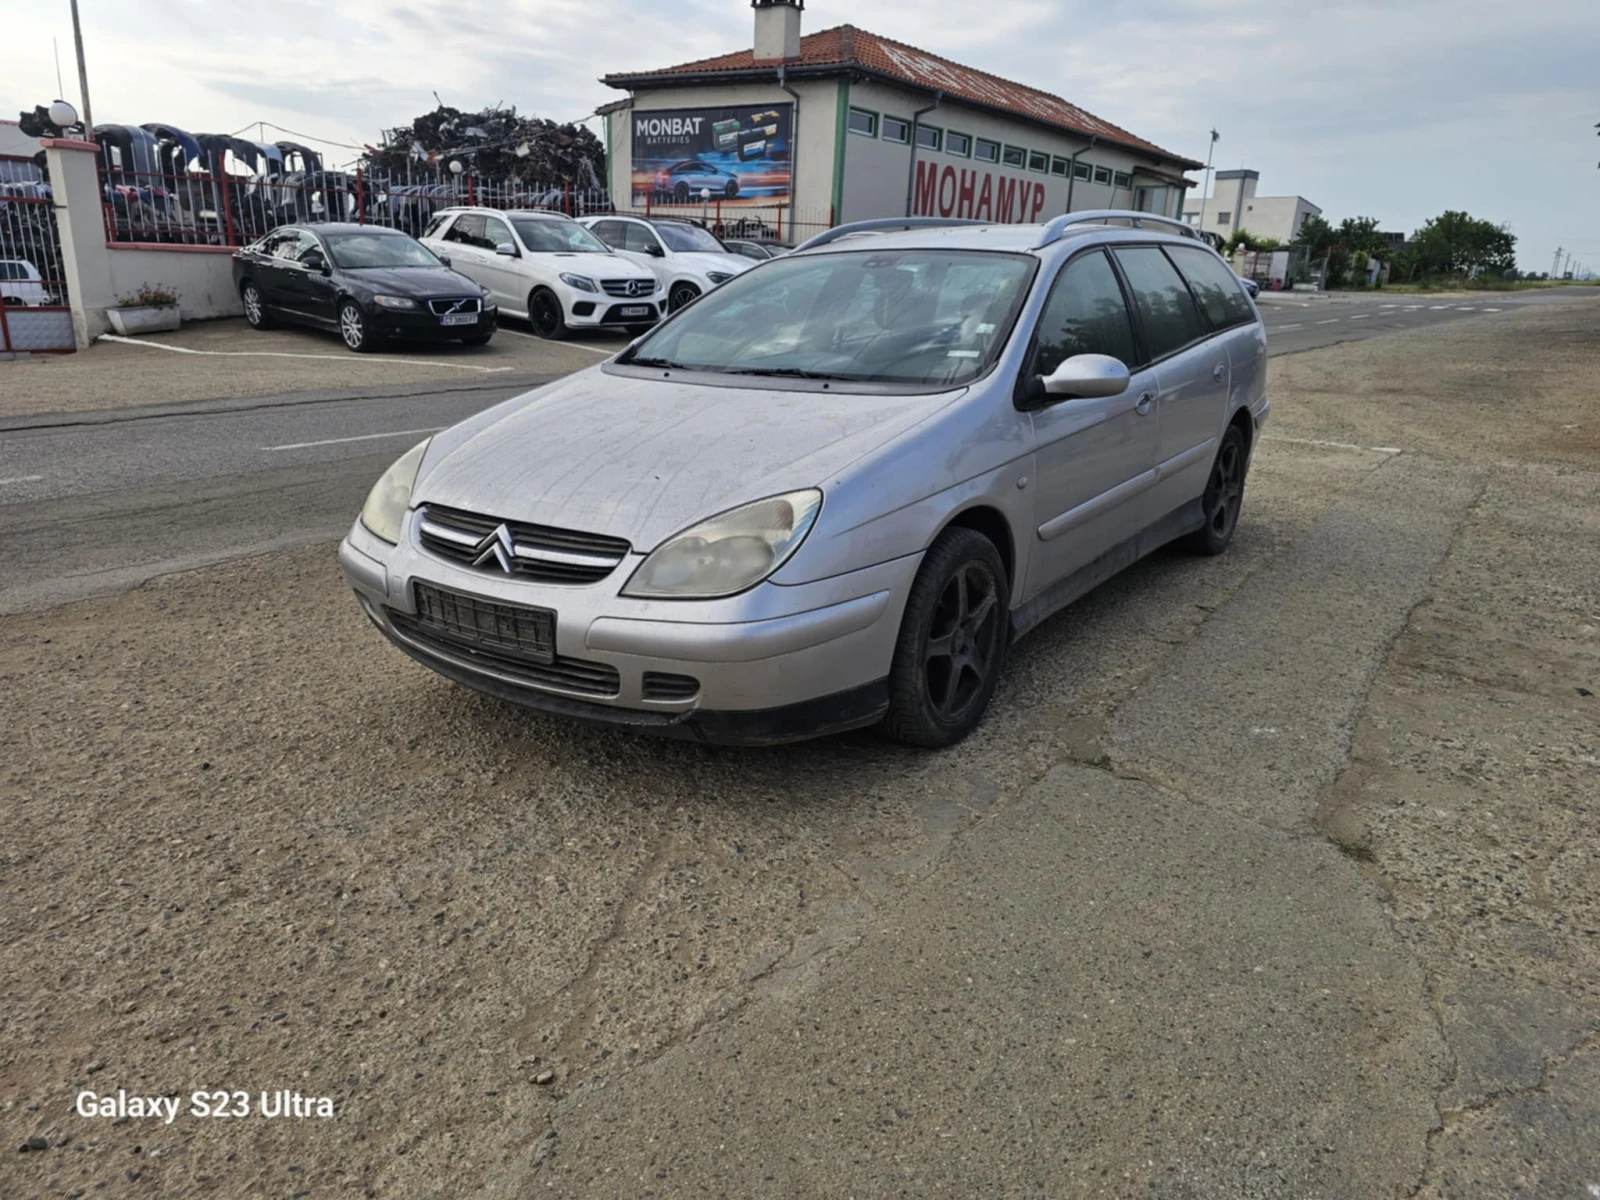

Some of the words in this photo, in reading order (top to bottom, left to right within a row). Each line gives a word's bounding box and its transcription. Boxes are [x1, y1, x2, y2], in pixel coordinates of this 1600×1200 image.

[636, 117, 702, 136] MONBAT
[646, 135, 690, 145] BATTERIES
[913, 159, 1046, 224] МОНАМУР
